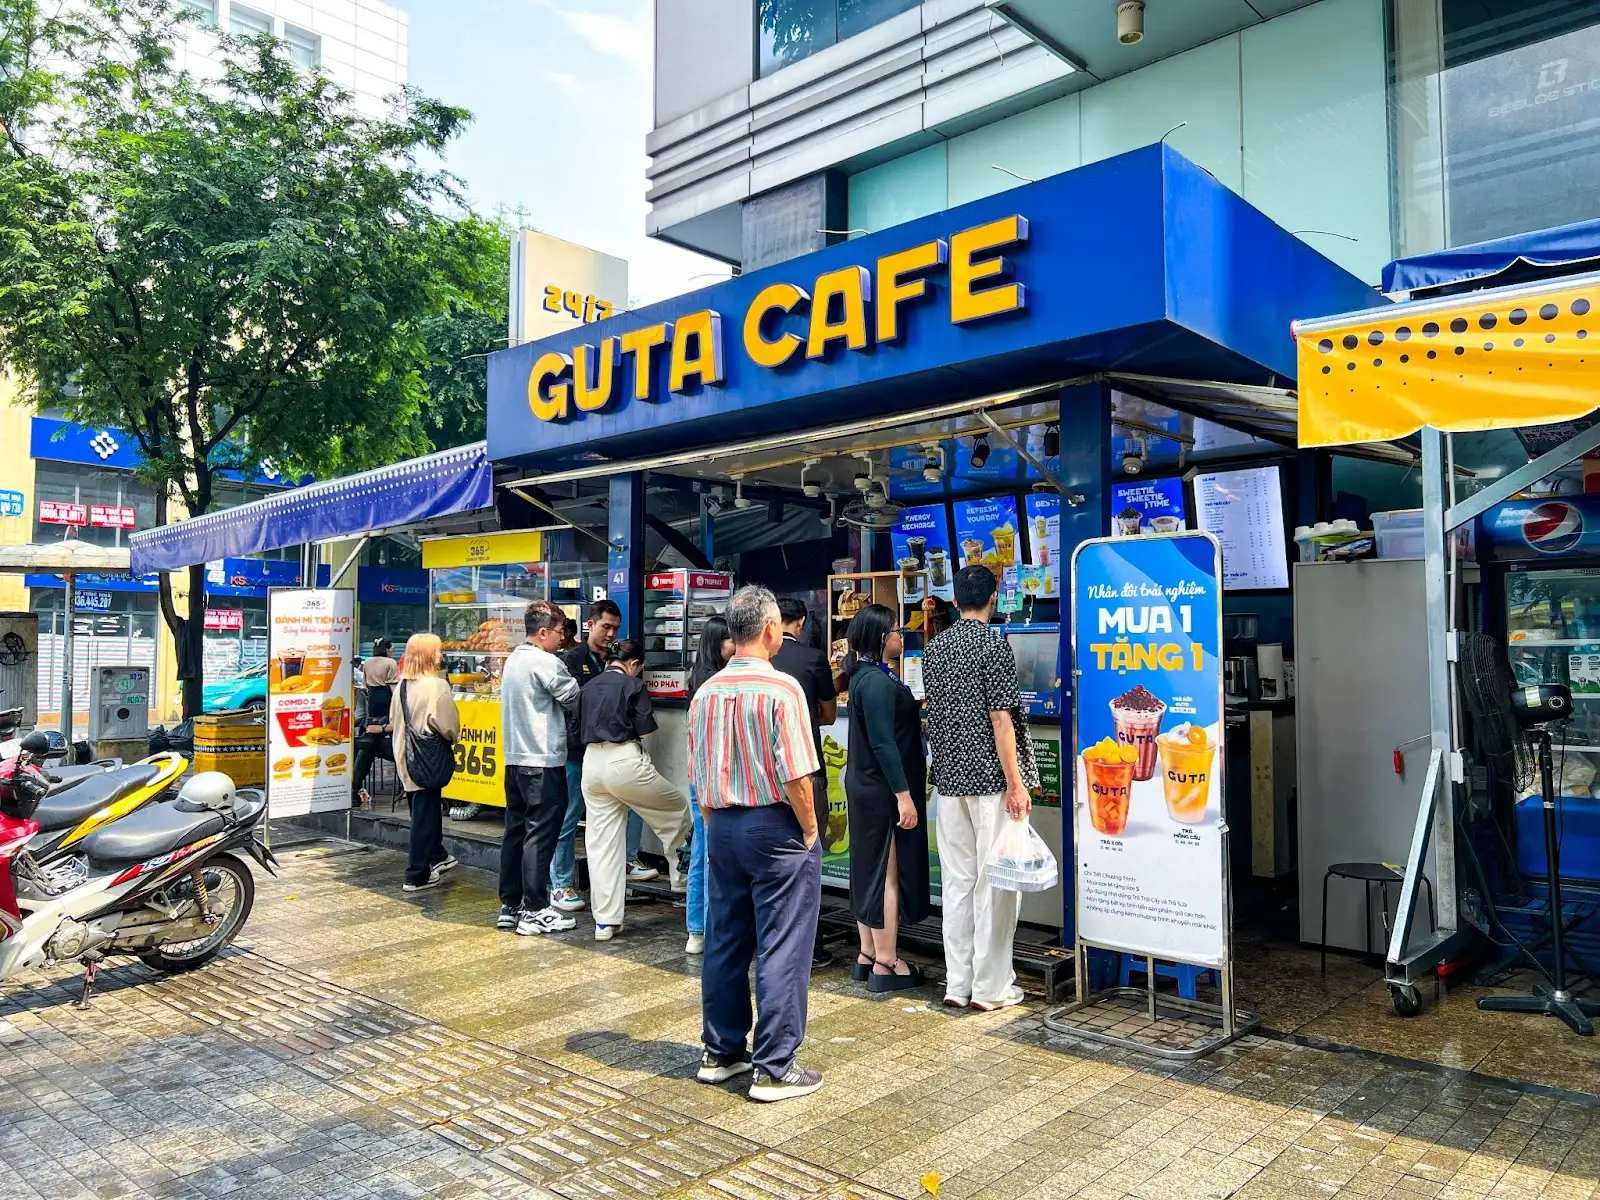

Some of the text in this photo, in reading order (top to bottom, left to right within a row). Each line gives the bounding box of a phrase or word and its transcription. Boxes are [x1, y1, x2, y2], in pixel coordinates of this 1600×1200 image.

[527, 214, 1028, 422] GUTA CAFE
[1118, 487, 1154, 497] SWEETIE
[1126, 493, 1164, 503] SWEETIE
[966, 505, 998, 514] REFRESH
[1148, 499, 1170, 508] TIME
[967, 515, 985, 523] YOUR
[902, 522, 936, 530] RECHARGE
[471, 546, 485, 555] 365
[613, 572, 624, 584] 41
[1088, 583, 1118, 599] Nhân
[1121, 582, 1139, 598] đôi
[1165, 580, 1206, 602] nghiệm
[1098, 605, 1192, 634] MUA 1
[1090, 636, 1203, 675] TẶNG 1
[278, 698, 309, 706] COMBO
[460, 724, 496, 744] ÁNH MÌ
[1118, 731, 1155, 744] GUTA
[453, 744, 496, 777] 365
[1168, 770, 1206, 784] GUTA
[1092, 783, 1127, 797] GUTA
